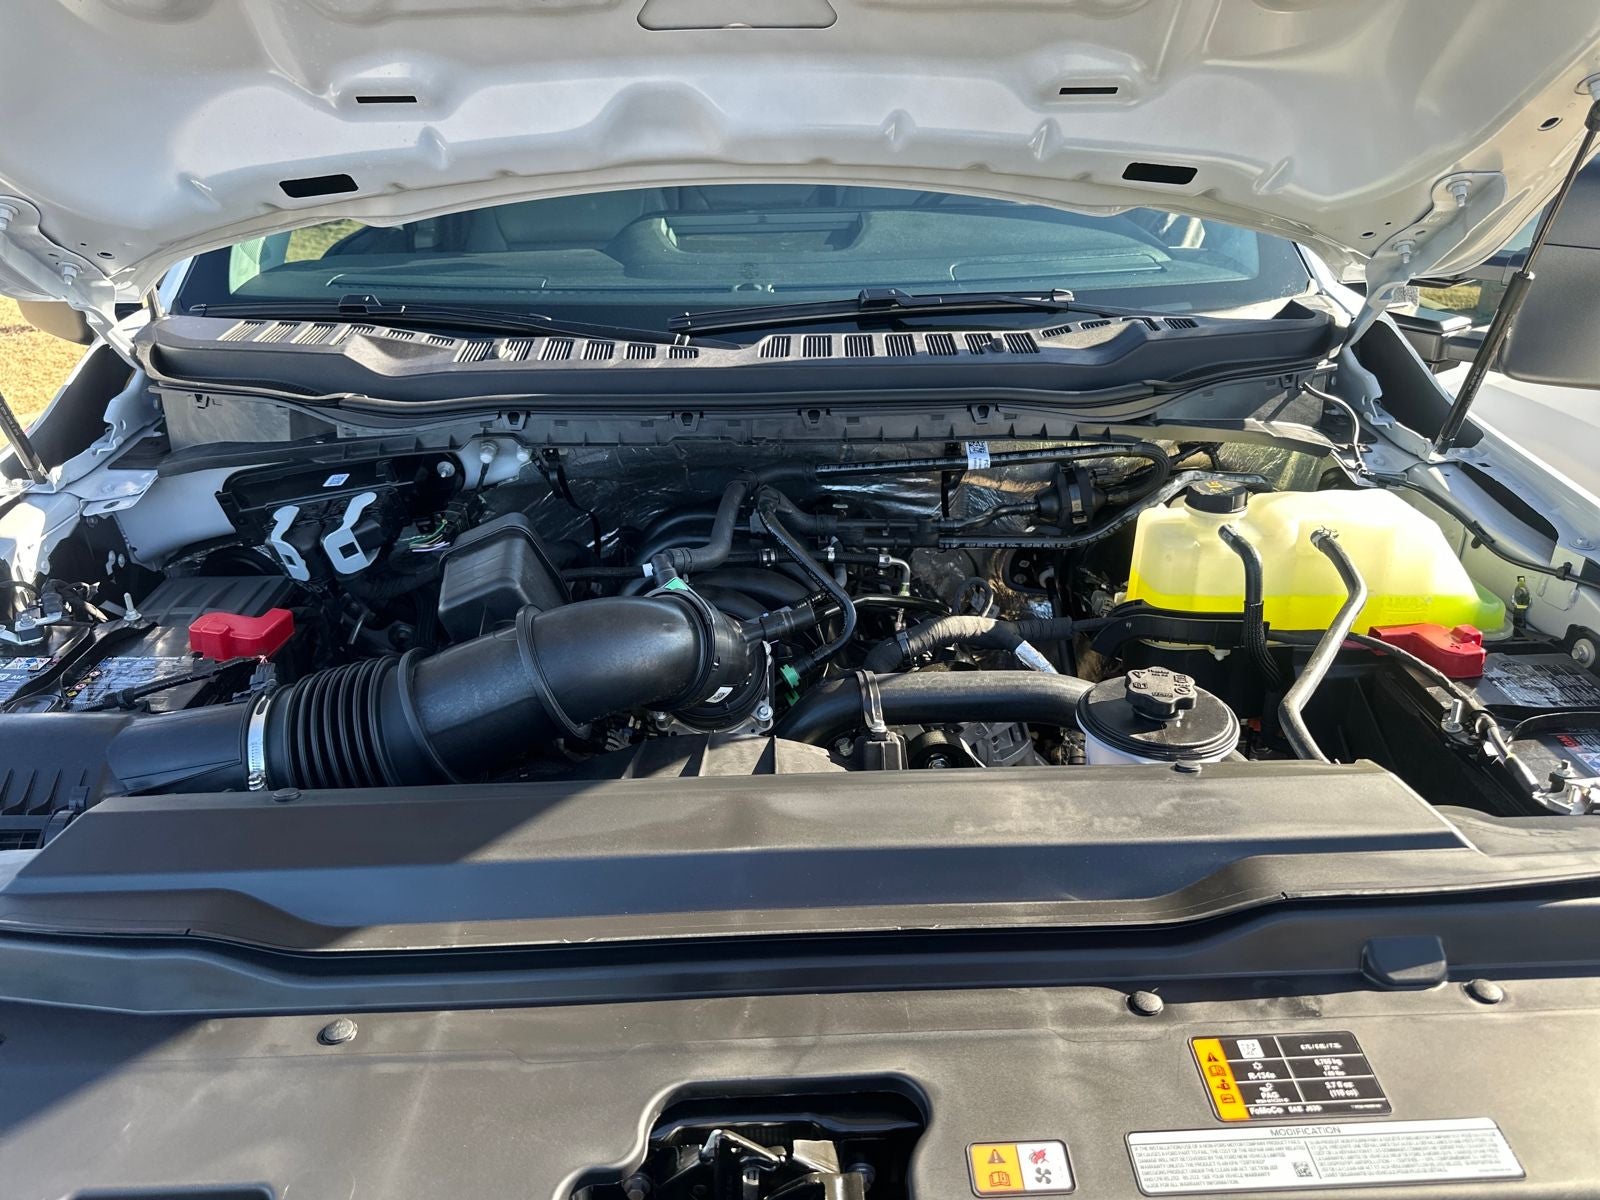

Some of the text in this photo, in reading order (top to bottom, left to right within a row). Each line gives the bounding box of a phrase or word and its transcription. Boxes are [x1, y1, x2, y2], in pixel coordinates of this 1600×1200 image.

[1248, 1071, 1277, 1080] R-134a
[1249, 1105, 1284, 1115] FoMoCo
[1270, 1126, 1342, 1136] MODIFICATION
